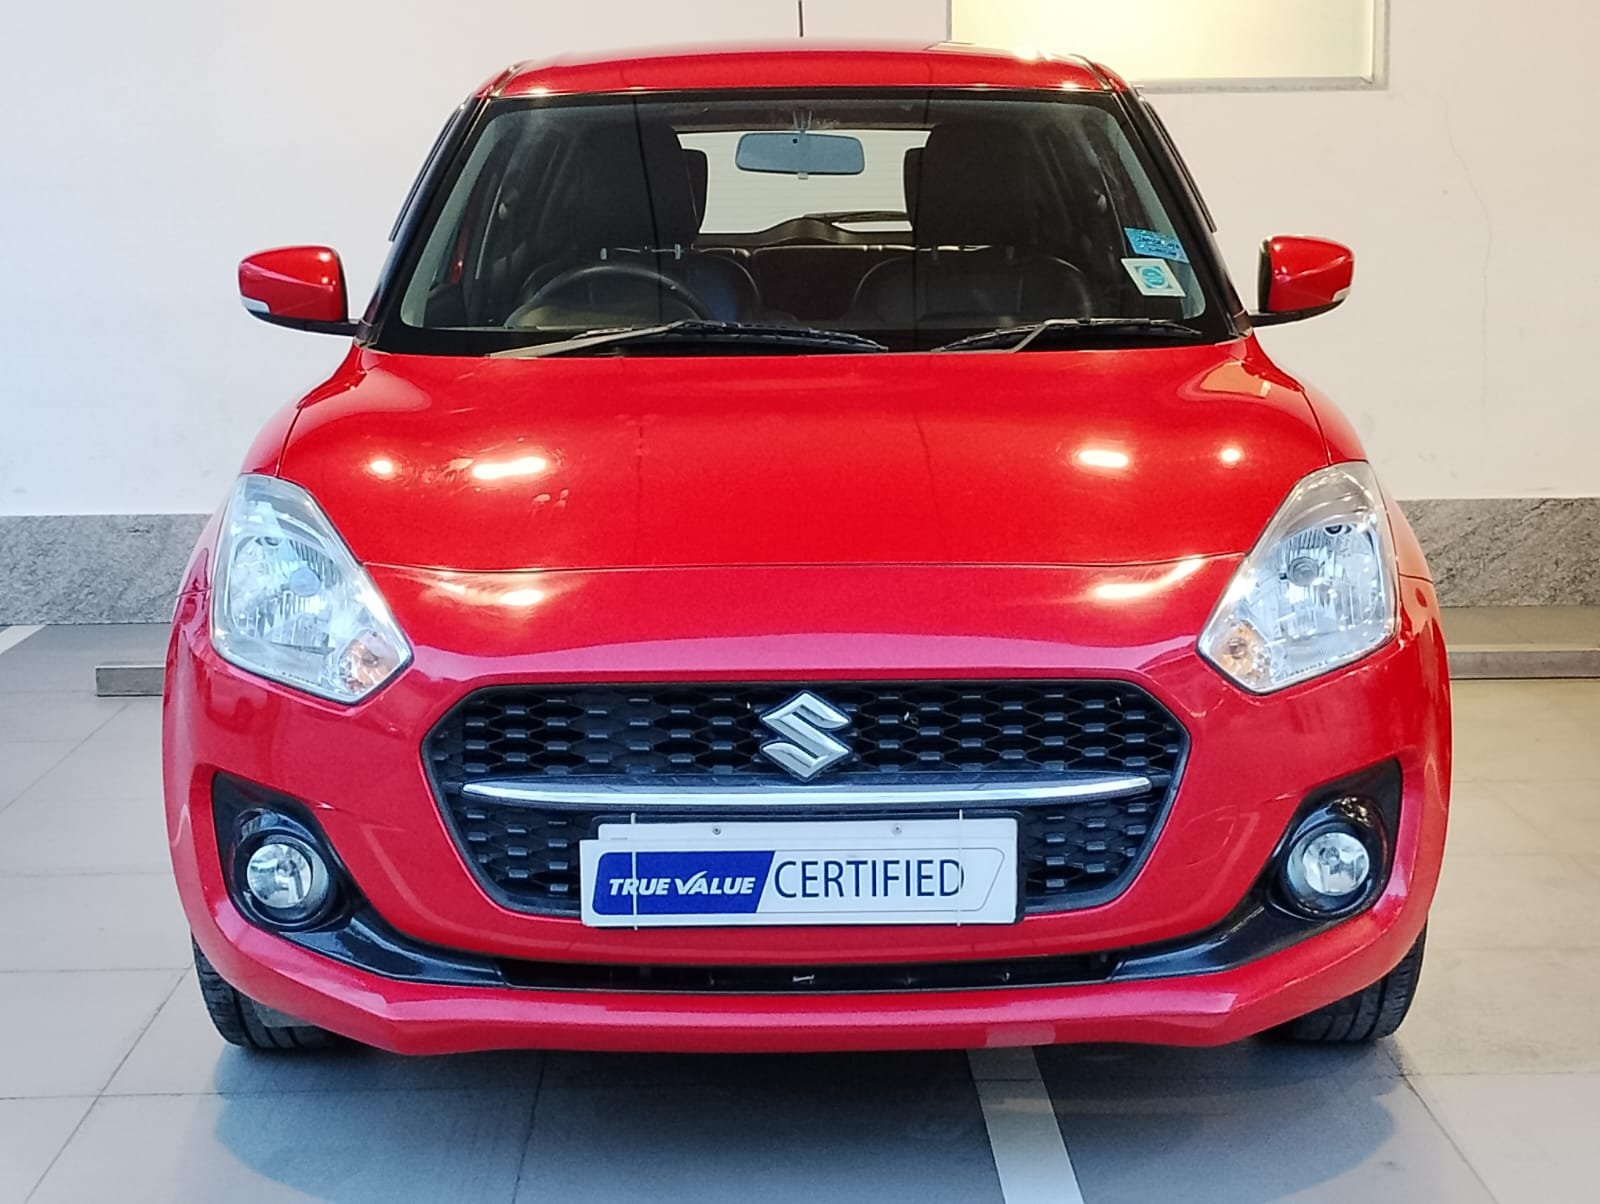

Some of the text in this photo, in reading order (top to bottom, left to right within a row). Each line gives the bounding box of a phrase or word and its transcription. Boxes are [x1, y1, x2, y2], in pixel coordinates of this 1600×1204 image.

[609, 859, 965, 898] TRUE VALUE CERTIFIED
